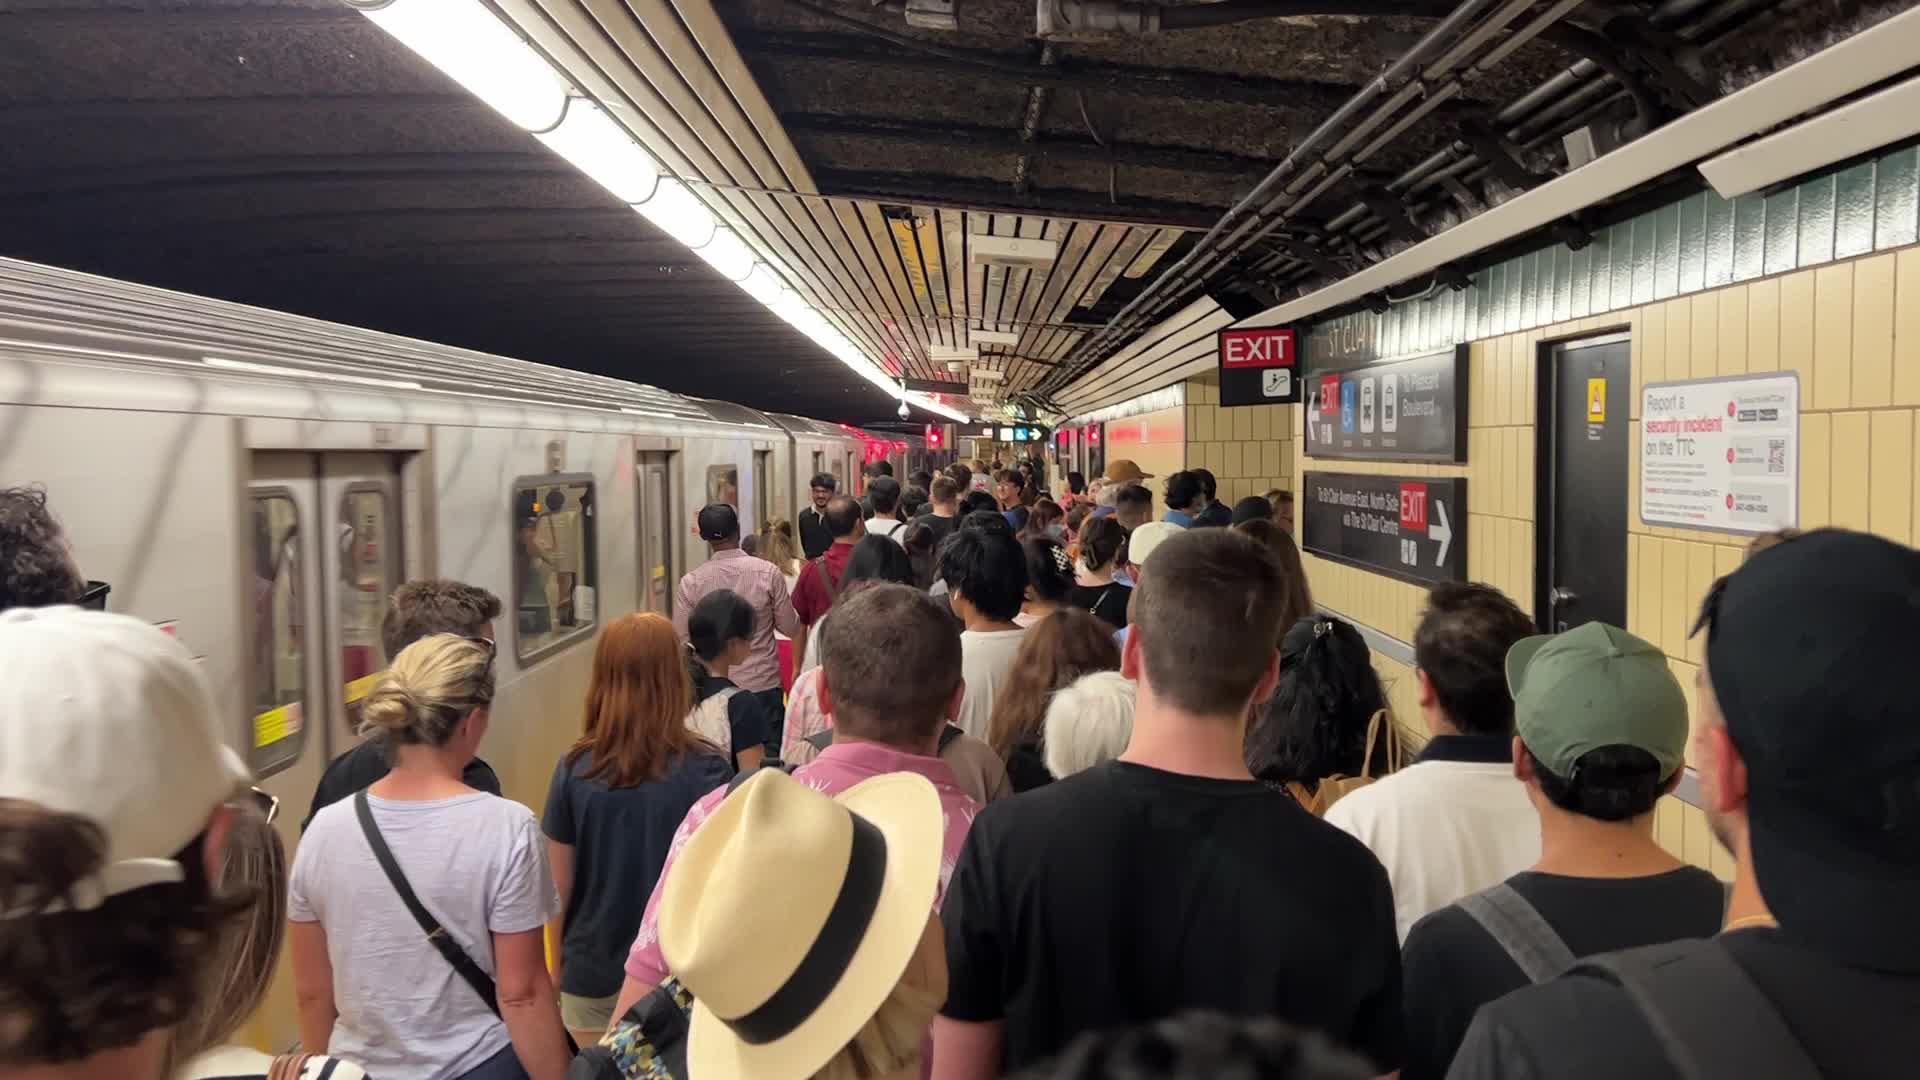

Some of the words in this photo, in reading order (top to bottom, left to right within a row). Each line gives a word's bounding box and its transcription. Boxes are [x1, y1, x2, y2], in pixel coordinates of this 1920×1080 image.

[1226, 336, 1290, 362] EXIT
[1328, 327, 1338, 357] ST
[1343, 322, 1376, 354] CLA
[1321, 382, 1339, 409] EXIT
[1647, 395, 1677, 414] Report
[1646, 418, 1680, 437] security
[1684, 416, 1723, 433] incident
[1646, 444, 1657, 456] on
[1659, 440, 1673, 456] the
[1676, 437, 1696, 456] TTC
[1318, 487, 1324, 502] To
[1329, 488, 1339, 504] Clair
[1339, 490, 1357, 507] Avenue
[1370, 493, 1385, 510] North
[1386, 493, 1399, 512] Side
[1401, 490, 1427, 523] EXIT
[1351, 511, 1360, 529] The
[1361, 511, 1367, 530] St
[1367, 512, 1379, 532] Clair
[1380, 515, 1399, 536] Centre
